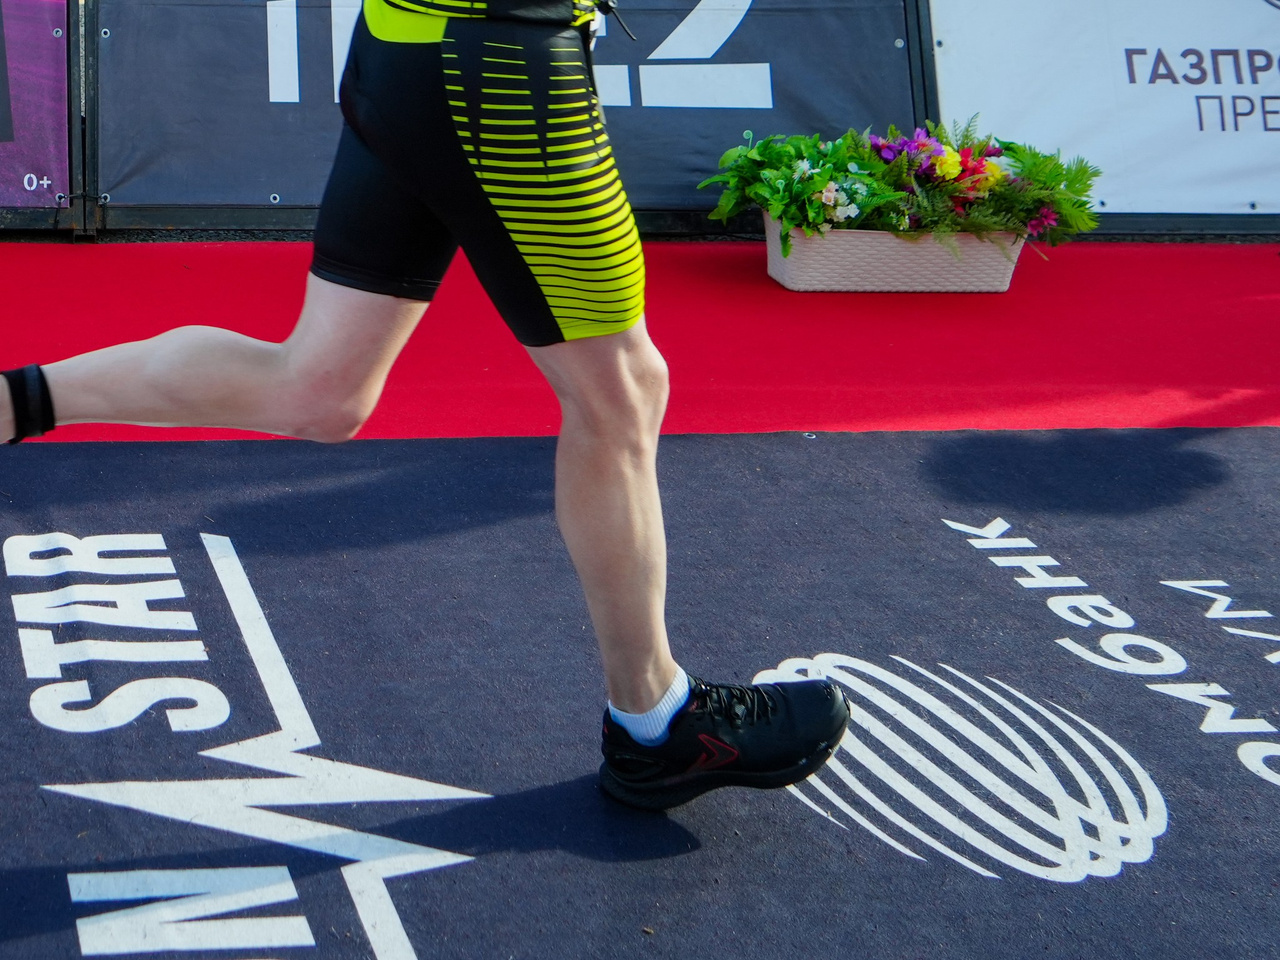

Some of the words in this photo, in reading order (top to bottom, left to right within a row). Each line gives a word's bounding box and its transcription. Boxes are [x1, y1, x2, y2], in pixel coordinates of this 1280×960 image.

[1124, 48, 1280, 85] ГАЗПР
[1195, 95, 1280, 132] ПРЕ
[23, 173, 52, 191] 0+
[2, 531, 231, 733] STAR
[67, 865, 317, 960] N
